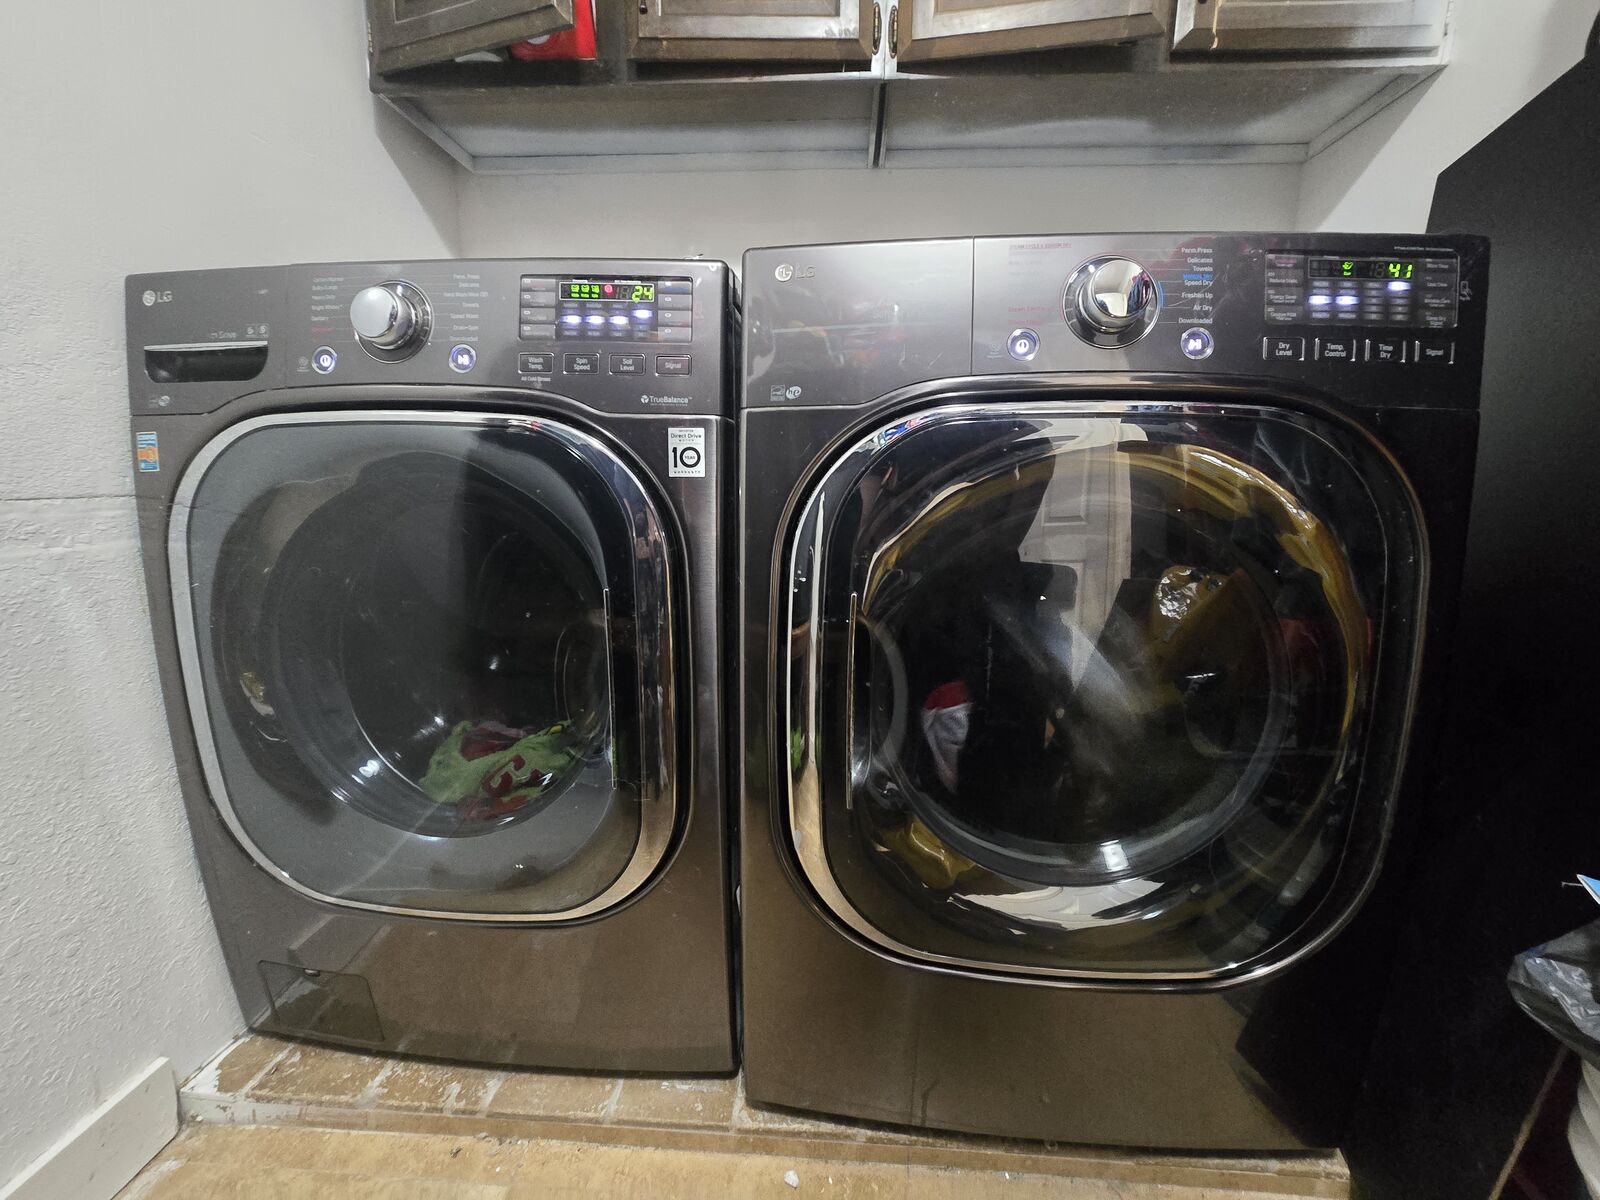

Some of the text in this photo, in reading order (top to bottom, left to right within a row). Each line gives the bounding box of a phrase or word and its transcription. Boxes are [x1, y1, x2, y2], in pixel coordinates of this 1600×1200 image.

[796, 264, 816, 279] LG
[1388, 263, 1413, 278] 41
[632, 286, 653, 303] 24
[1278, 342, 1290, 350] Dry
[1327, 343, 1344, 352] Temp.
[1275, 349, 1292, 357] Level
[1380, 351, 1391, 359] Dry
[1425, 348, 1443, 356] Signal
[576, 357, 588, 365] Spin
[665, 362, 681, 370] Signal
[672, 446, 701, 468] 10
